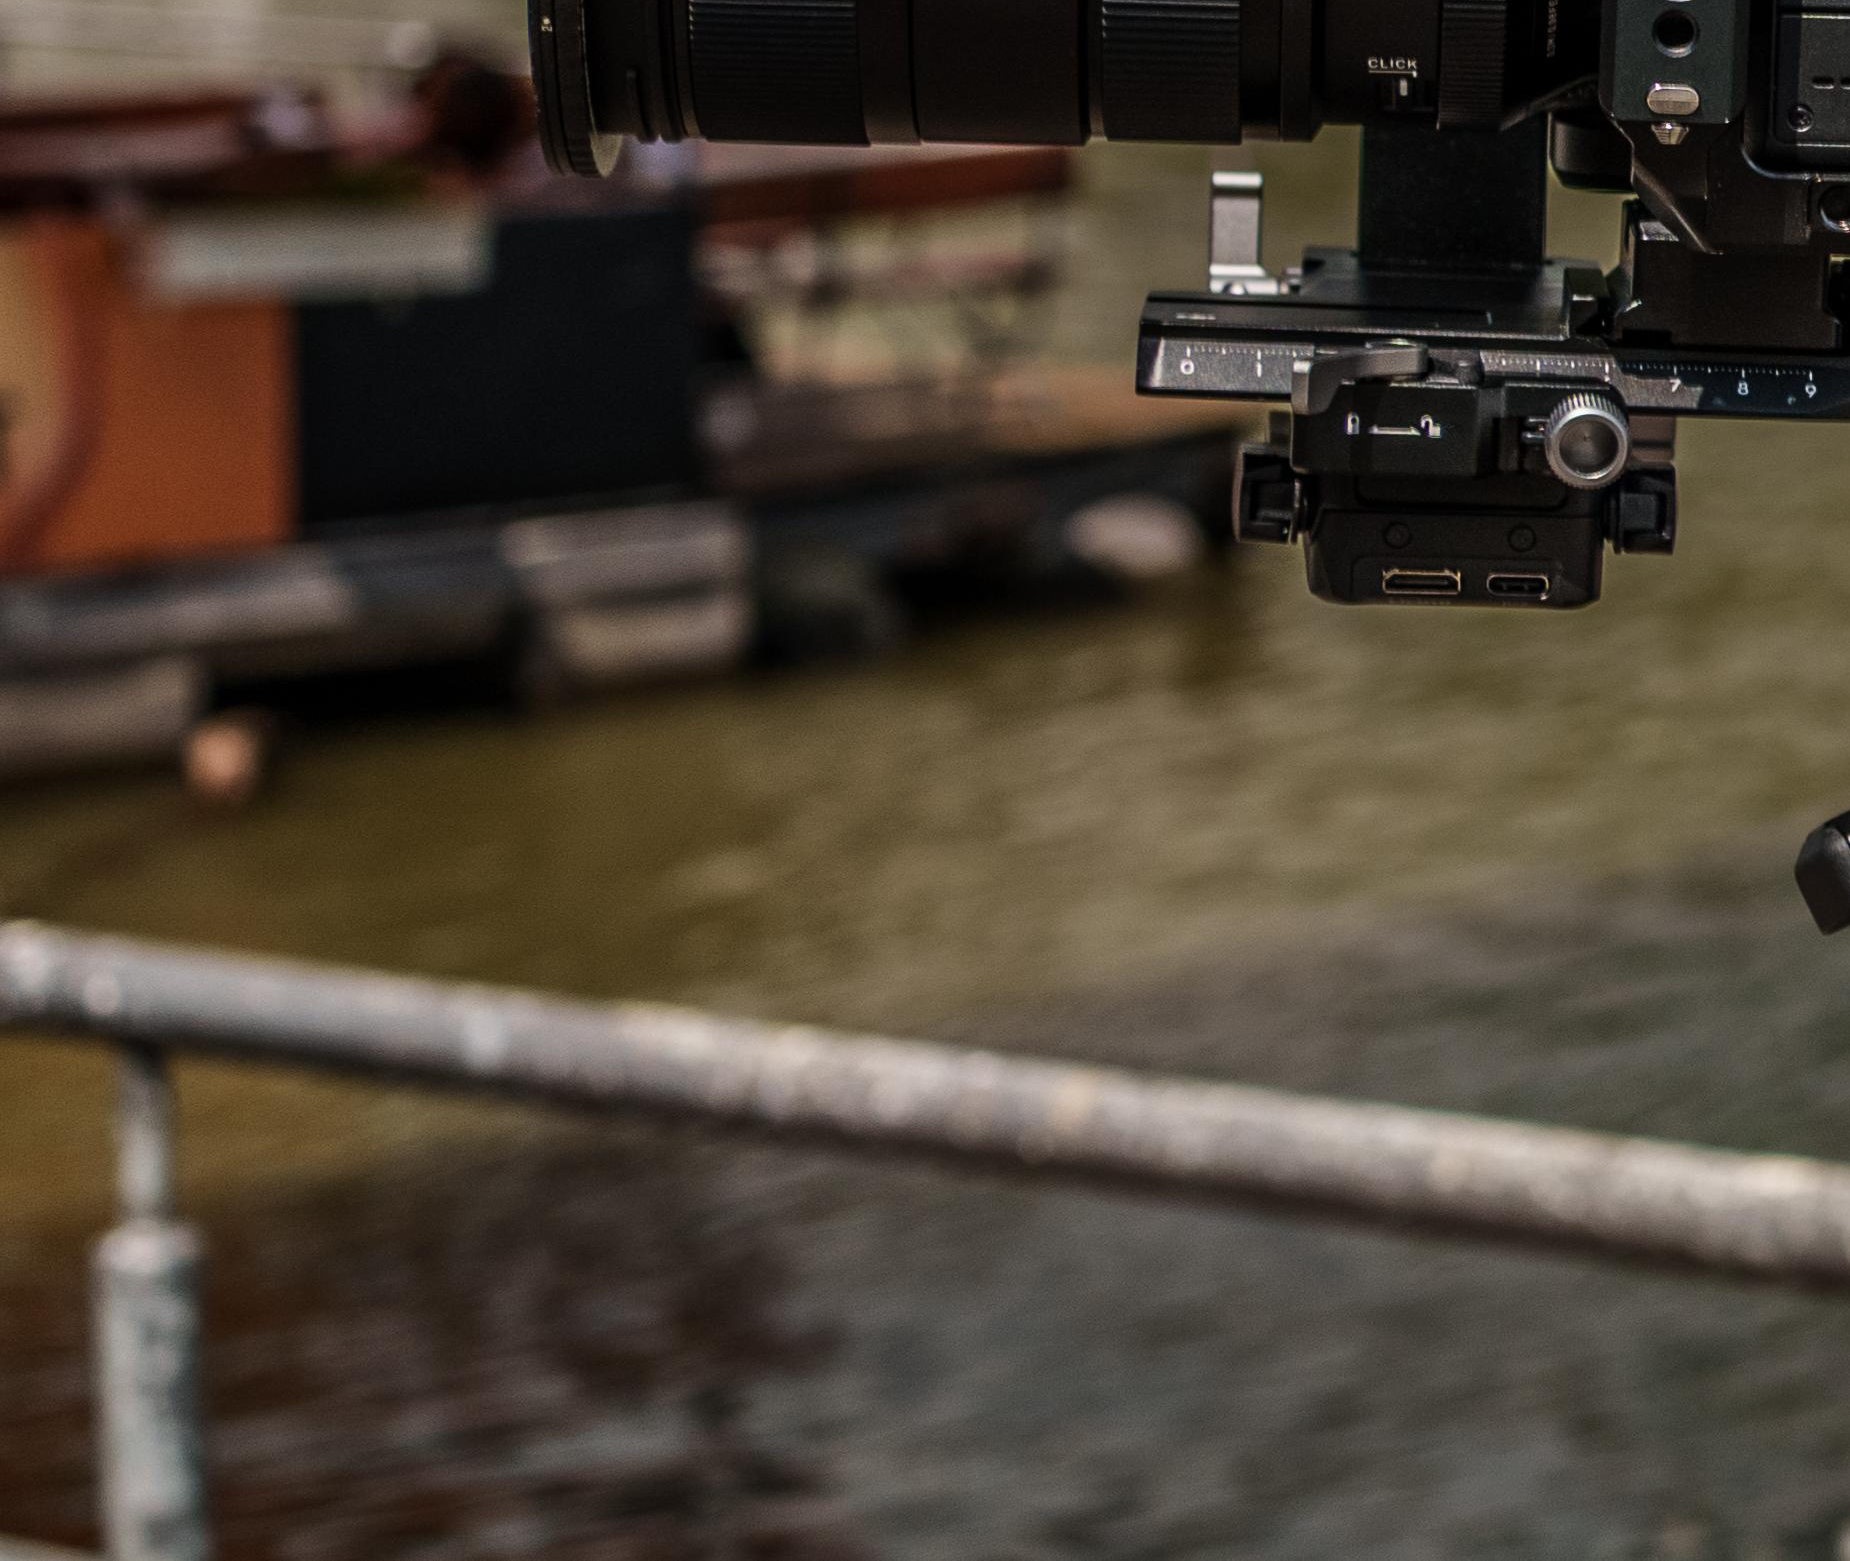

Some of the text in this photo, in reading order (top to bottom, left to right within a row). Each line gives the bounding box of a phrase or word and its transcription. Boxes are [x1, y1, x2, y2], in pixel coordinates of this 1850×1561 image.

[1368, 56, 1417, 70] CLICK
[1180, 359, 1195, 375] 0
[1669, 378, 1682, 393] 7
[1737, 381, 1749, 396] 8
[1805, 383, 1817, 398] 9
